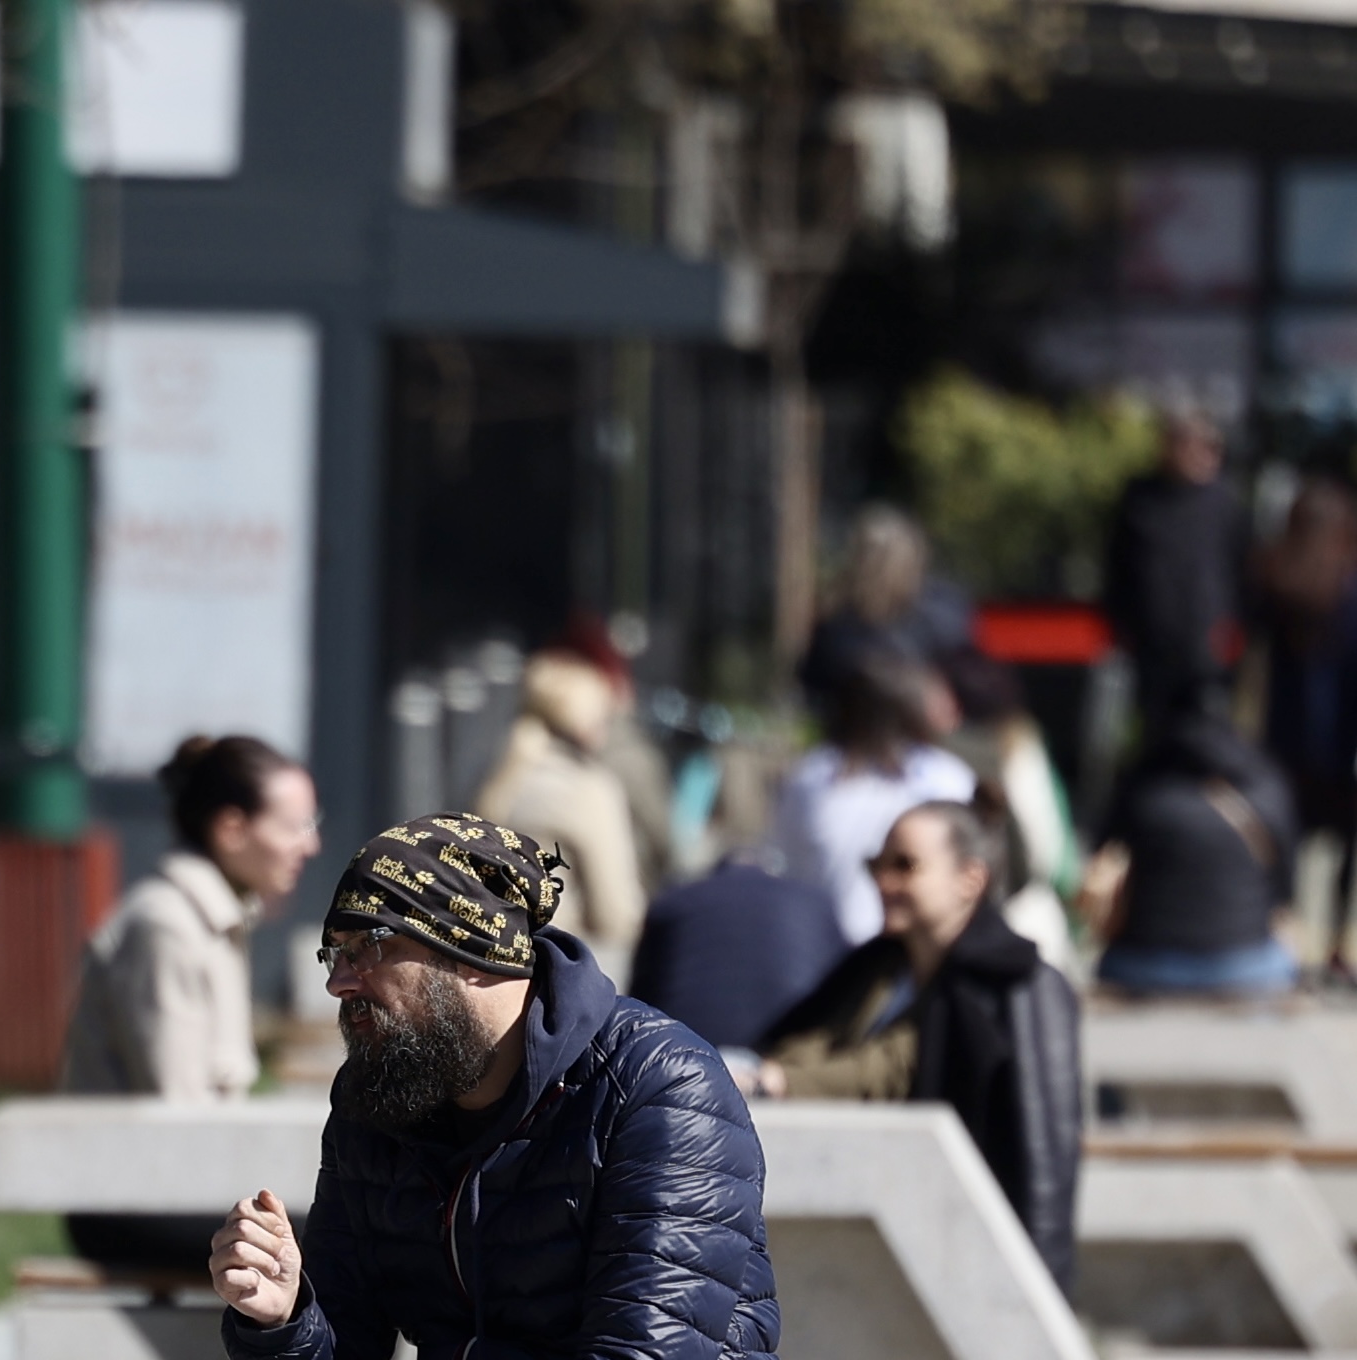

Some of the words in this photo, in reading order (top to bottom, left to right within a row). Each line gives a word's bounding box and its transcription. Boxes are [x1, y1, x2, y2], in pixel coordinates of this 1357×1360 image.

[376, 854, 406, 873] Jack
[372, 862, 424, 894] Wolfskin
[450, 894, 484, 917] Jack
[406, 907, 440, 927] Jack
[449, 900, 501, 939] Wolfskin
[489, 943, 516, 959] Jack
